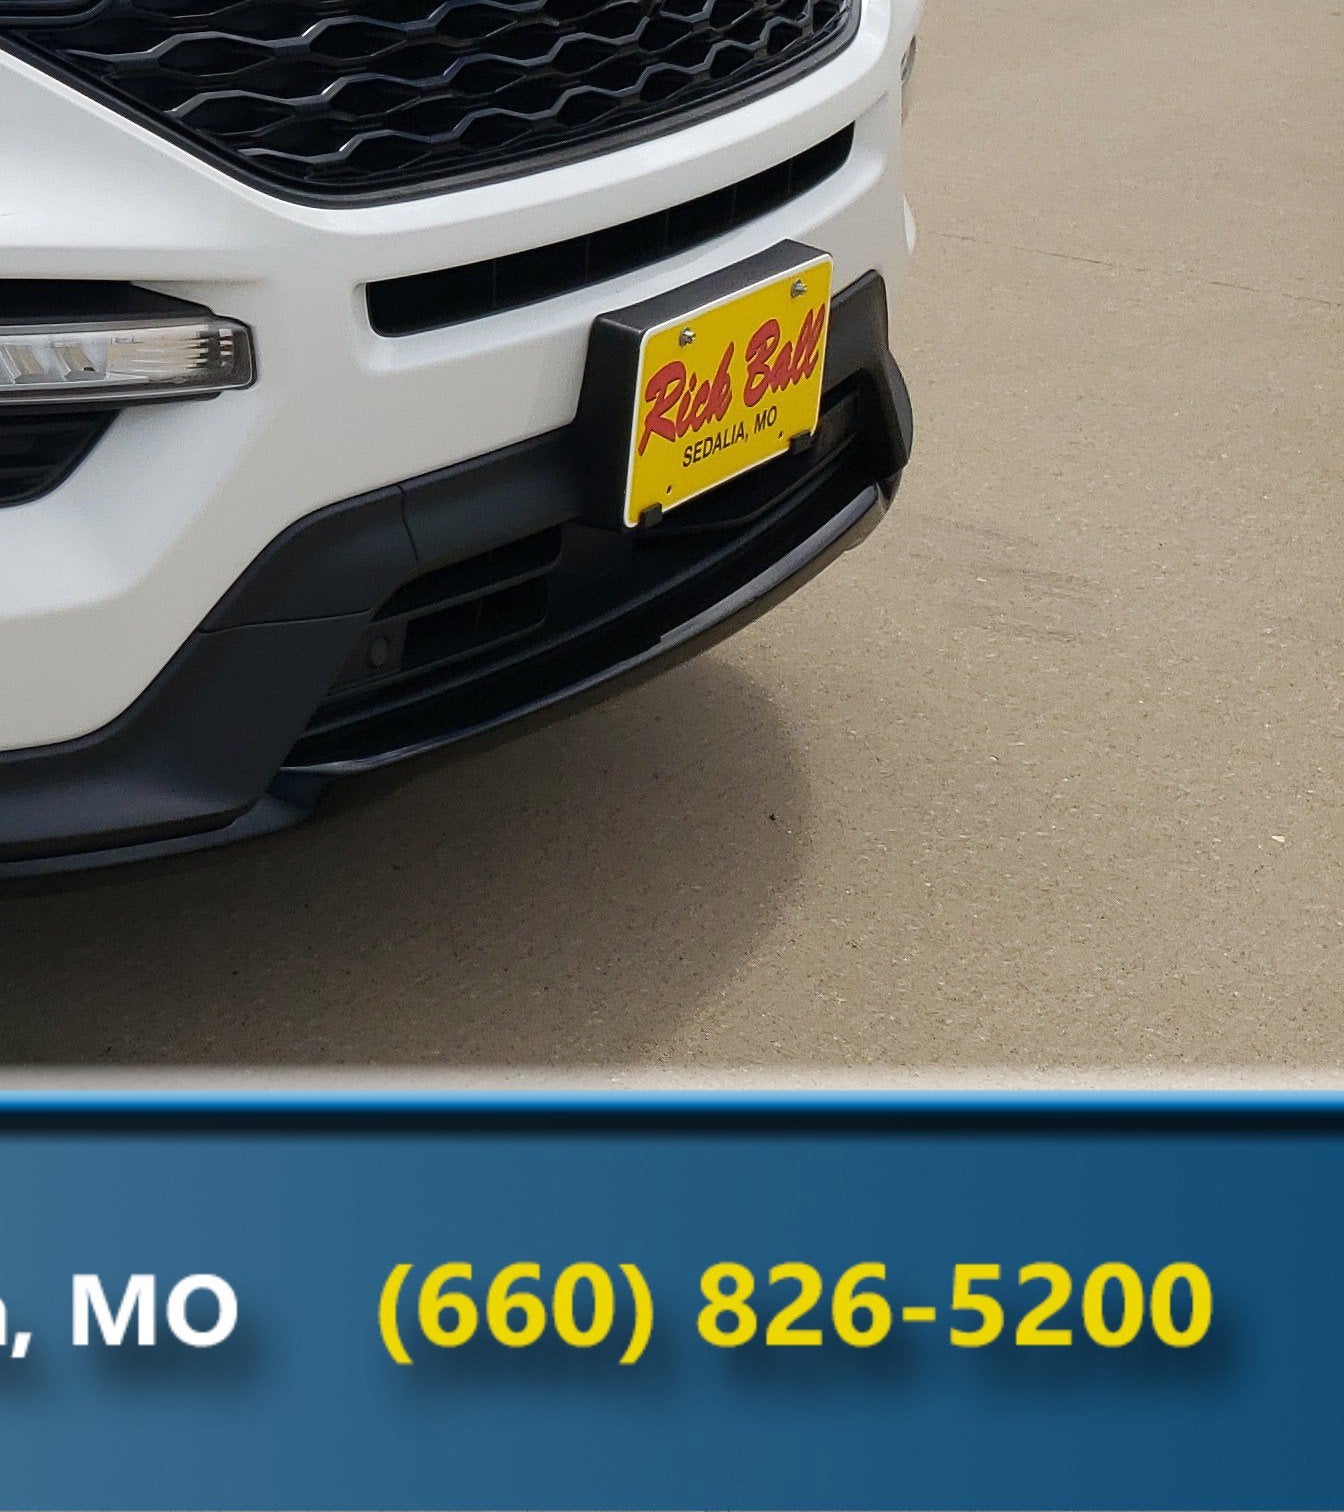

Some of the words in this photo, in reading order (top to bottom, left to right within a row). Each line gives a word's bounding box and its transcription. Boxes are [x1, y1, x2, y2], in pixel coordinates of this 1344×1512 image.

[637, 340, 735, 457] Rick
[742, 302, 826, 408] Ball
[682, 421, 749, 469] SEDALIA,
[753, 405, 778, 432] MO
